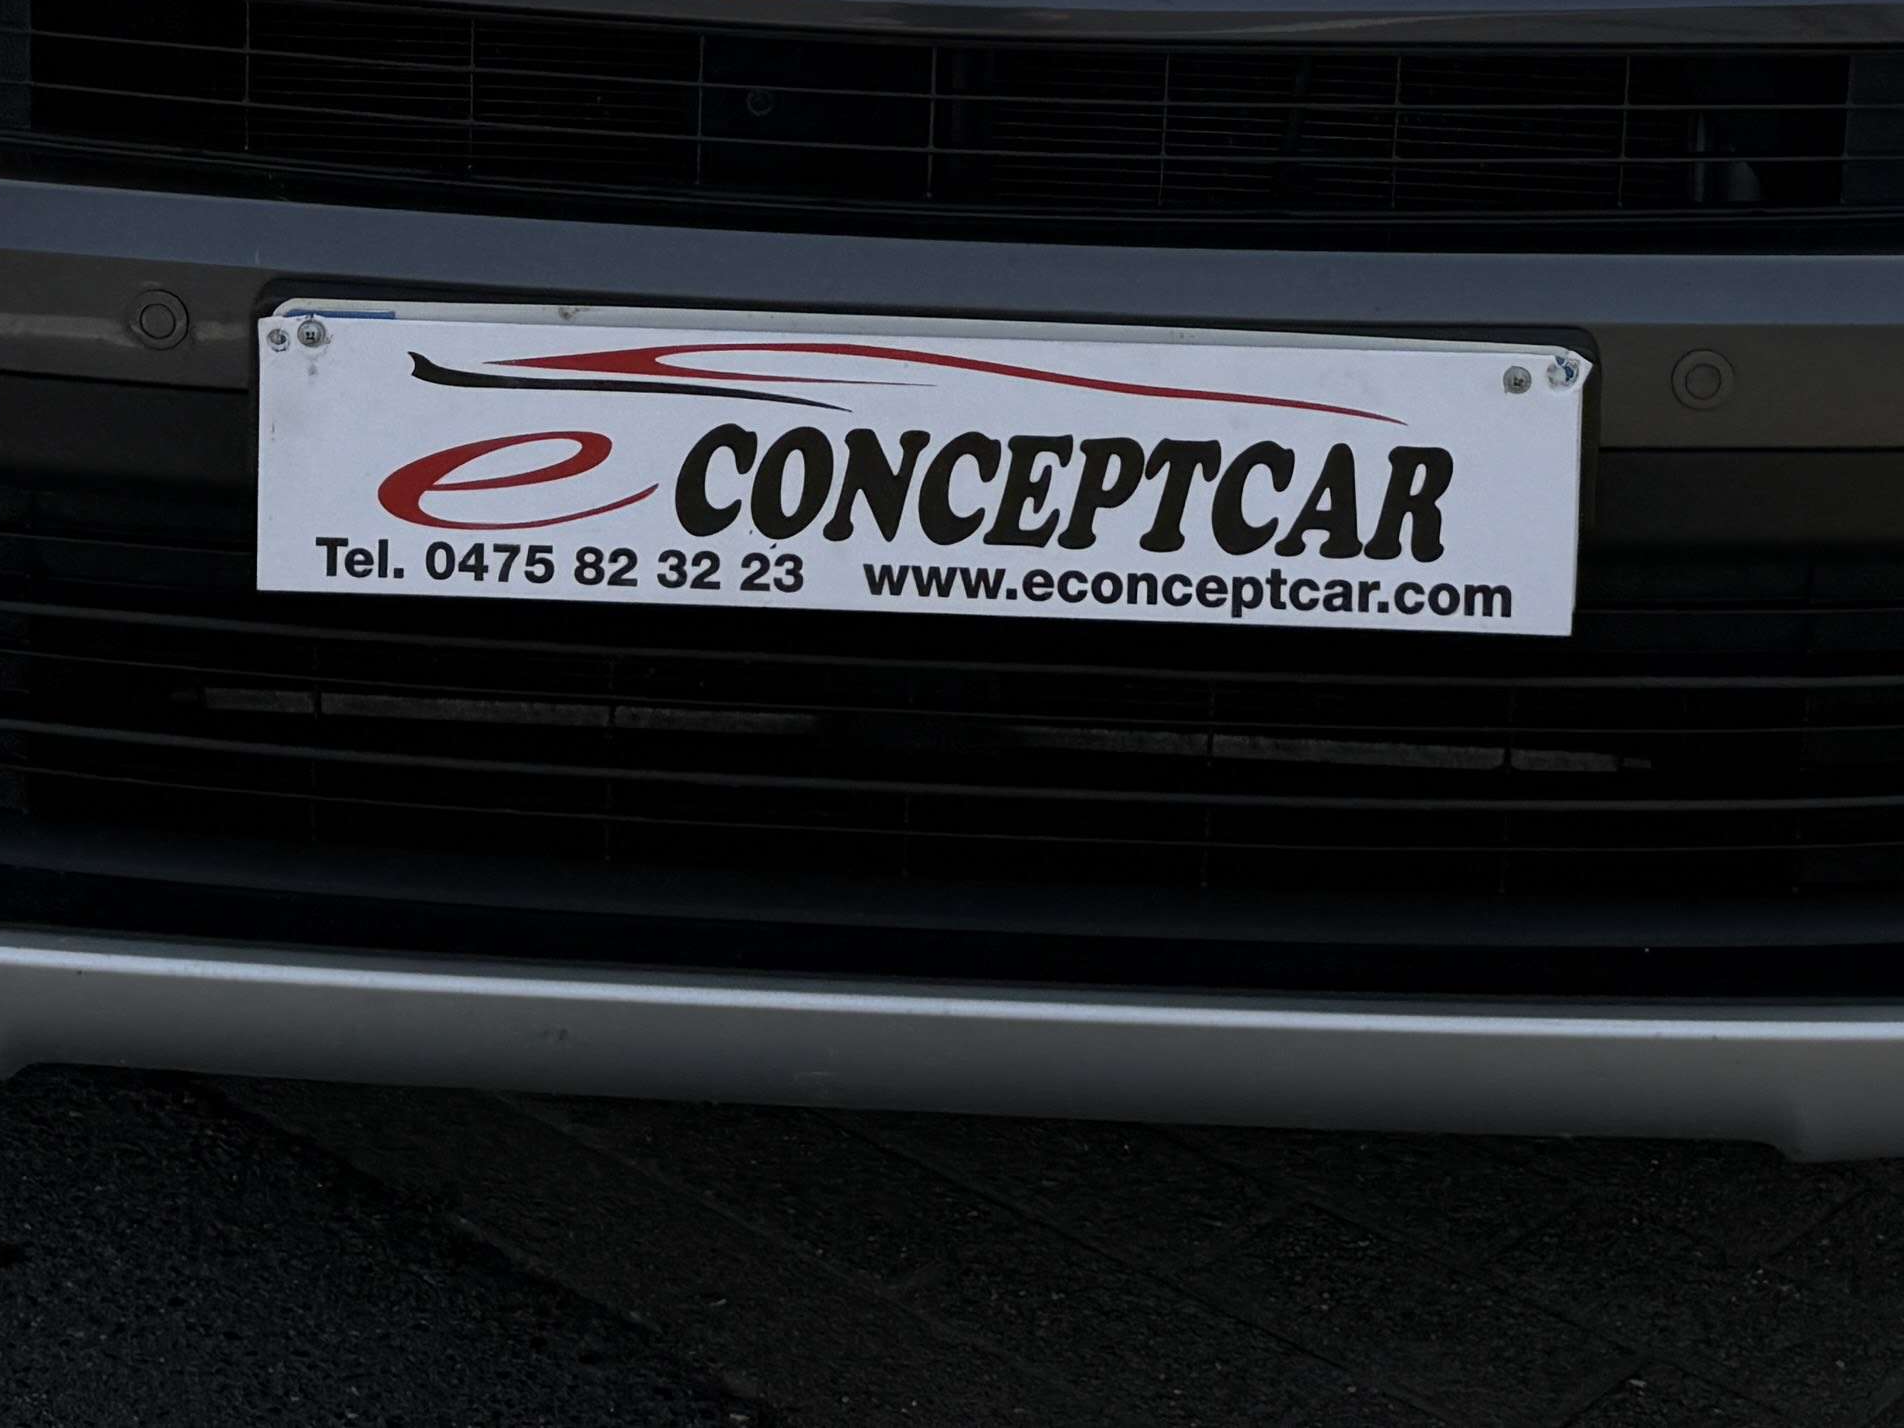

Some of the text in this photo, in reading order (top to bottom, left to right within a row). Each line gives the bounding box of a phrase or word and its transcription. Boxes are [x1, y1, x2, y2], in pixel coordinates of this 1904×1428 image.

[673, 422, 1455, 564] CONCEPTCAR
[315, 537, 1513, 619] Tel. 0475 82 32 23 www.econceptcar.com
